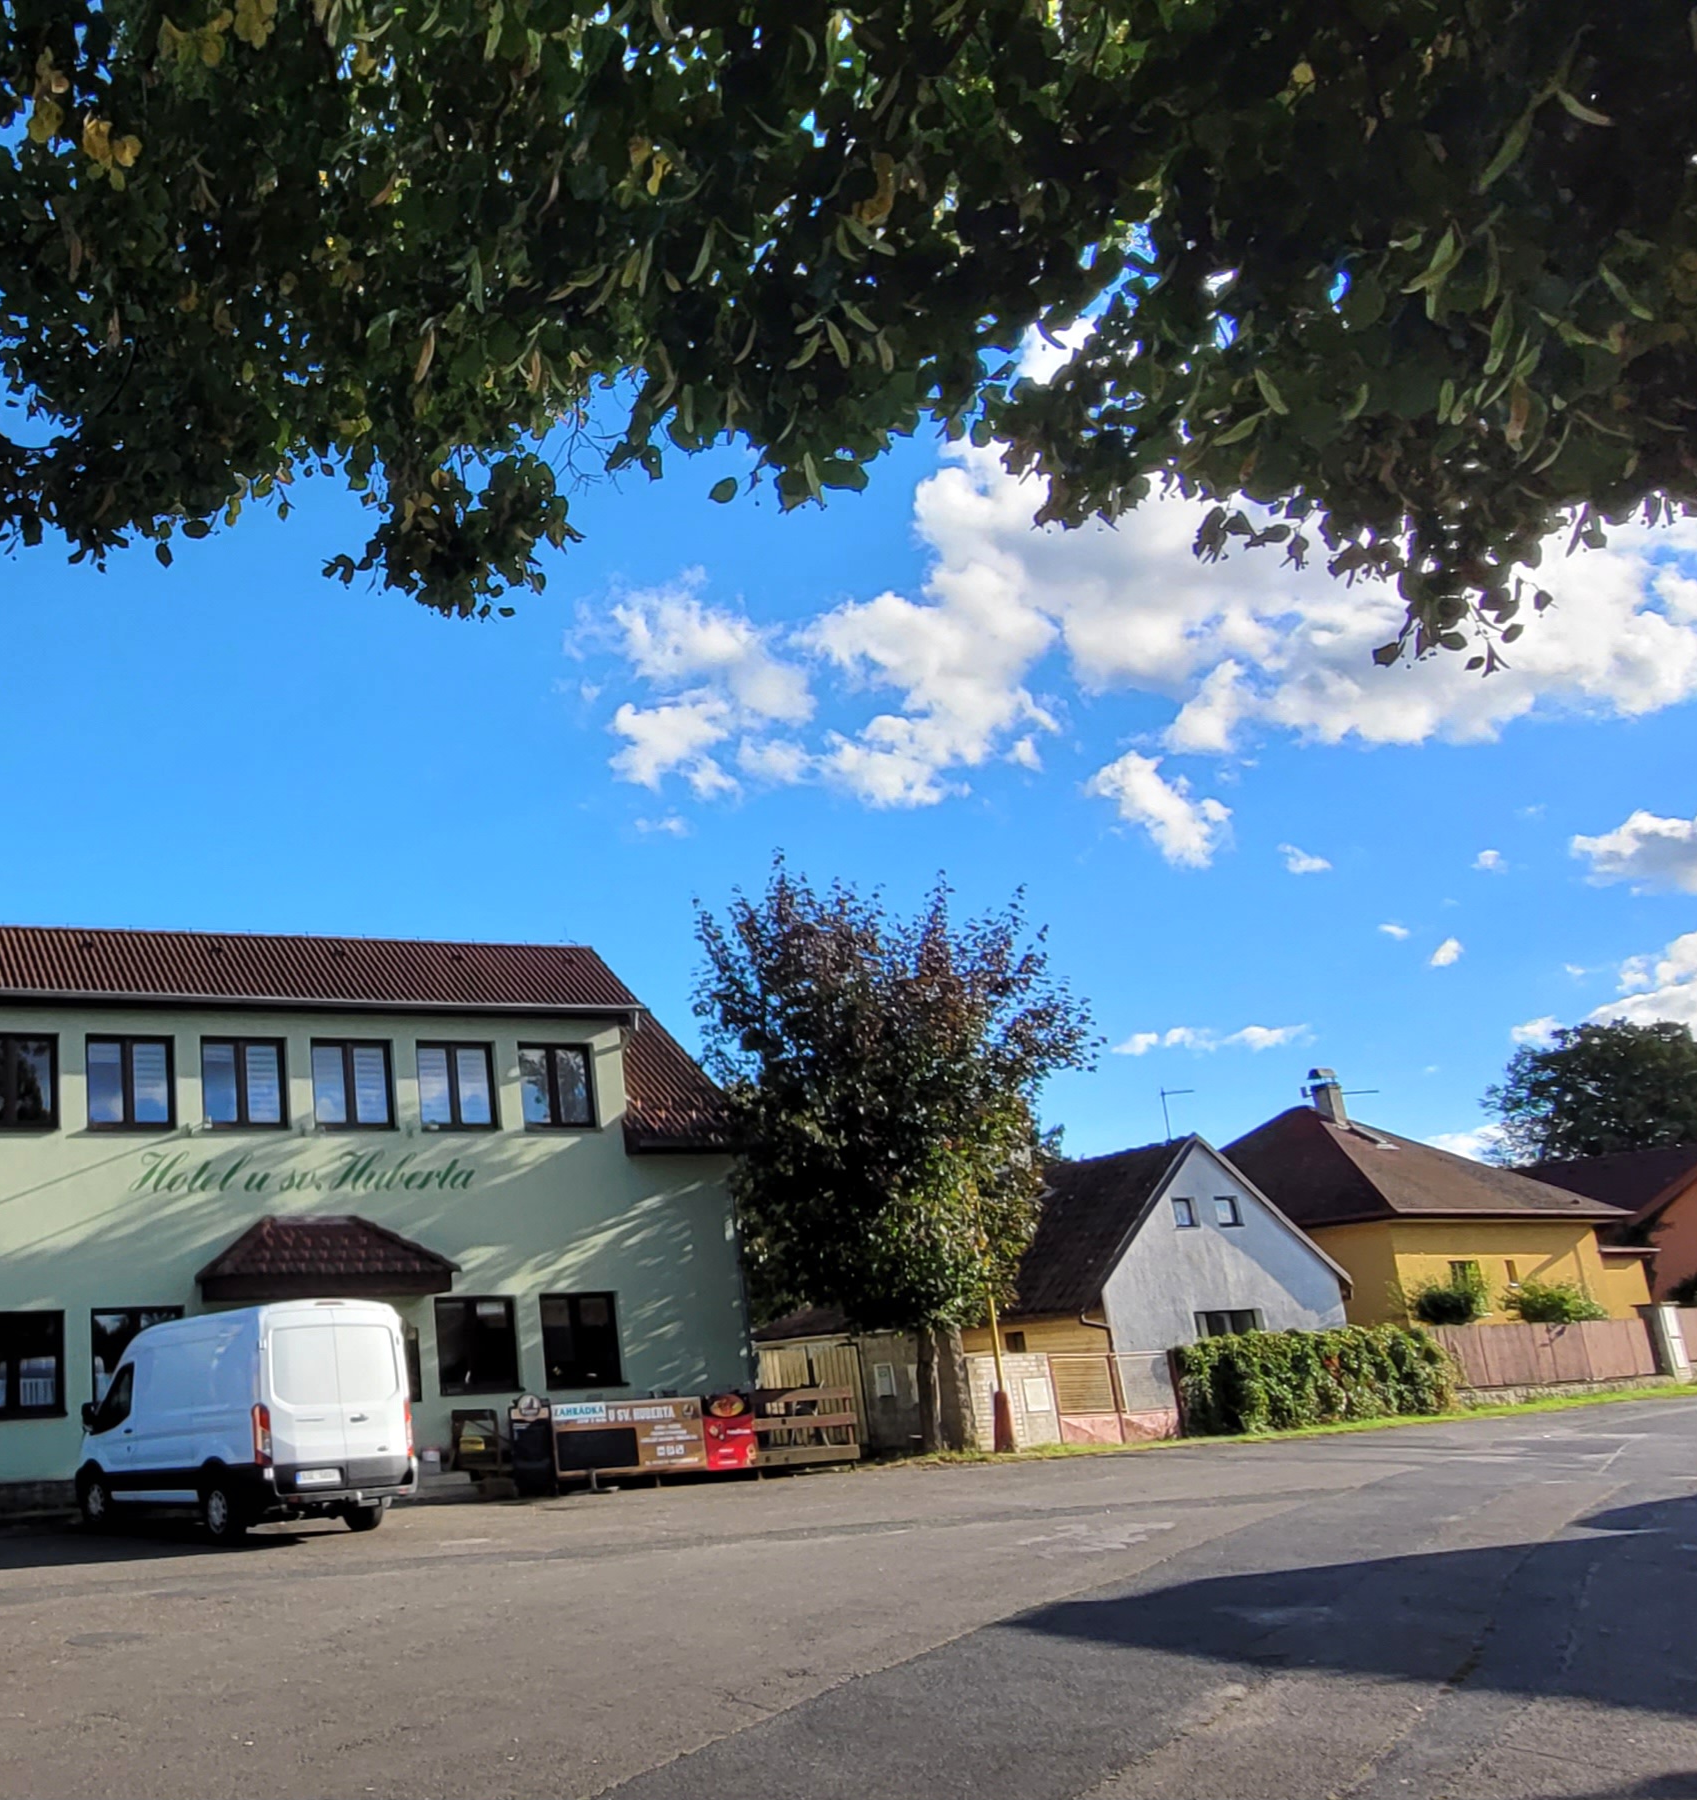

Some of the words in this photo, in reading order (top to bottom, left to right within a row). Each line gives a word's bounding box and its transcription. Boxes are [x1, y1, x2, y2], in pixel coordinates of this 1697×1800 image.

[128, 1151, 252, 1193] Hotel
[243, 1168, 272, 1193] u
[279, 1168, 324, 1193] sv.
[330, 1150, 478, 1192] Huberta
